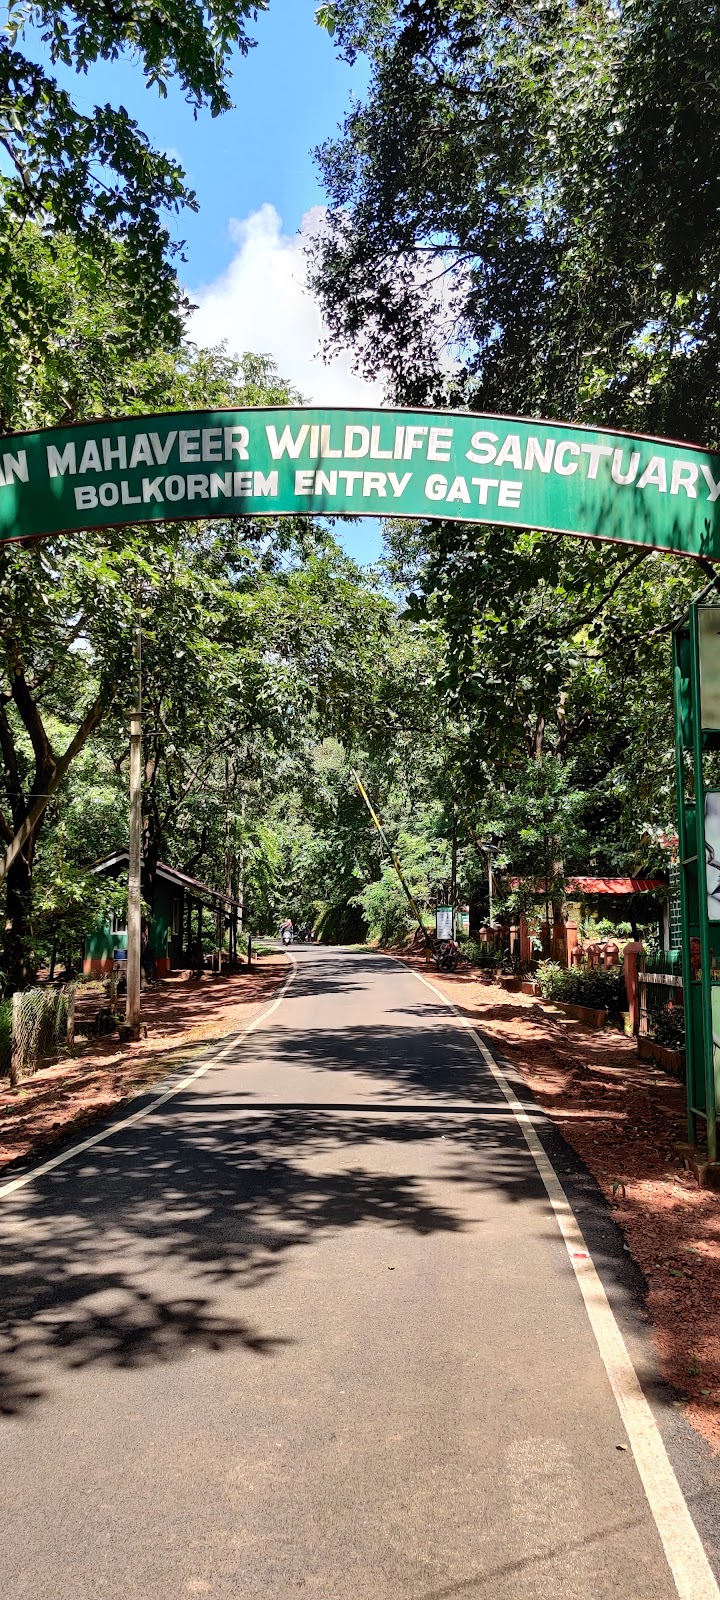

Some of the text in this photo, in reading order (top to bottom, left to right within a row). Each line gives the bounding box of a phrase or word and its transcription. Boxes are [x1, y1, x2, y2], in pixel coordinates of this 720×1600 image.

[0, 425, 720, 502] N MAHAVEER WILDLIFE SANCTUARY
[74, 470, 523, 511] BOLKORNEM ENTRY GATE
